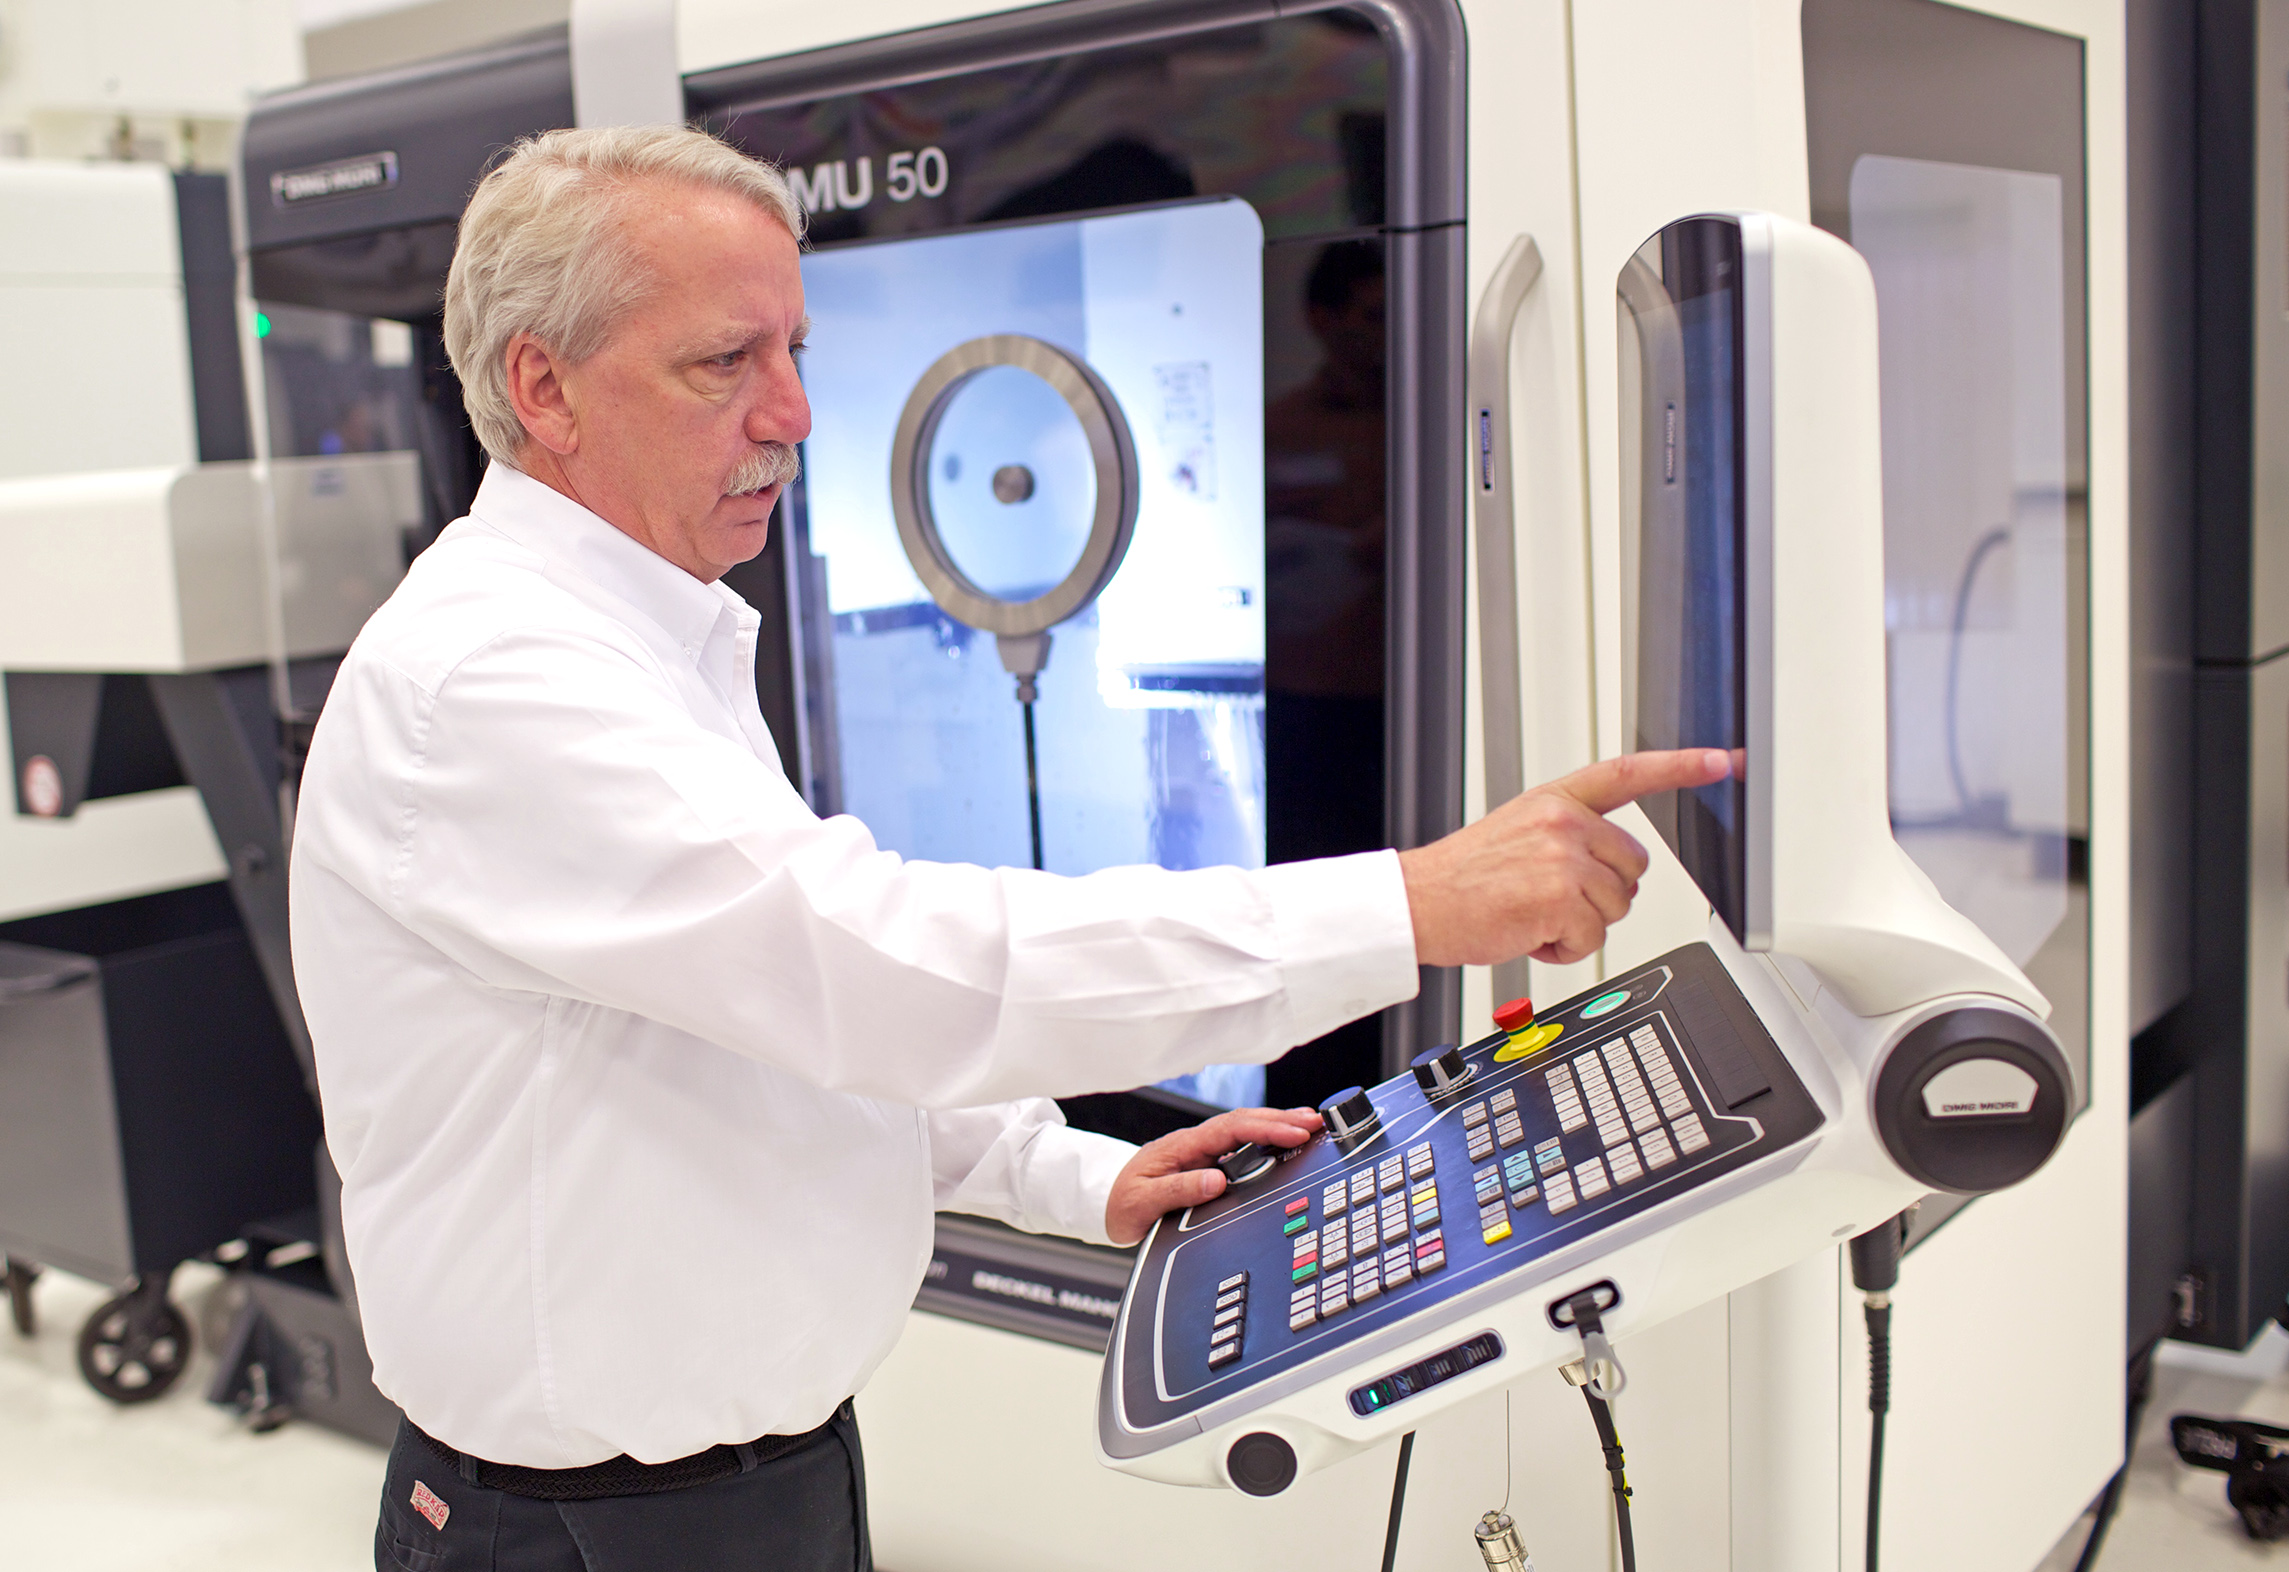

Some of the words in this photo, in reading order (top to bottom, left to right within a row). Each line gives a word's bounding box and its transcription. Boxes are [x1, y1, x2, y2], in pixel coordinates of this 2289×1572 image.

[886, 146, 949, 203] 50
[1941, 1103, 1977, 1113] DMG
[1979, 1100, 2019, 1112] MORI
[415, 1488, 430, 1500] RED
